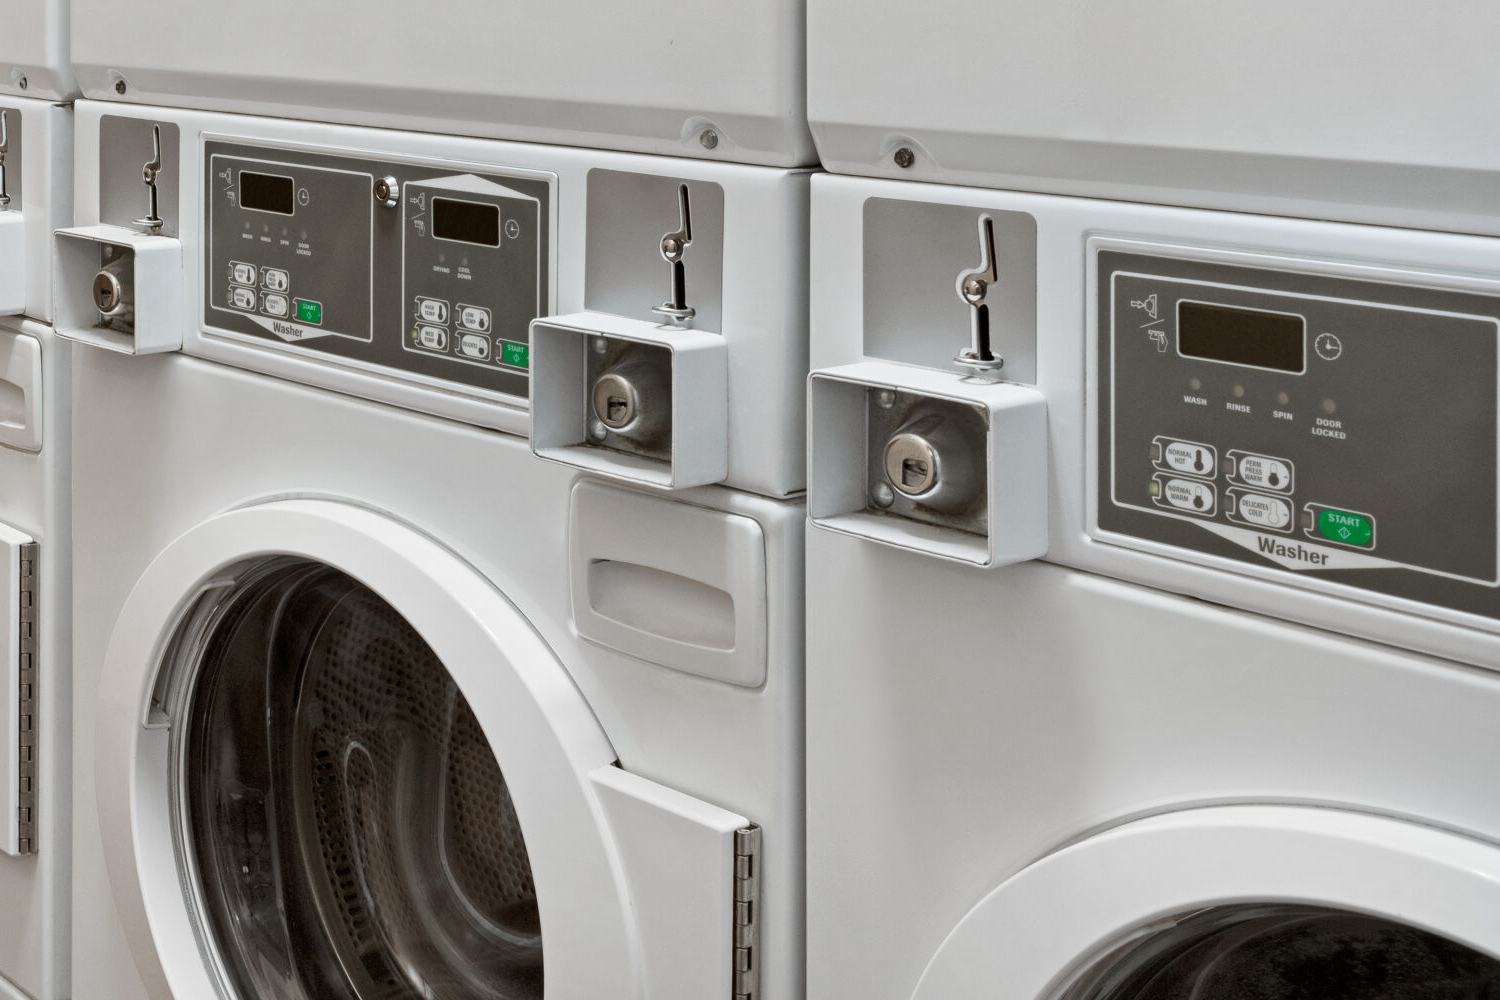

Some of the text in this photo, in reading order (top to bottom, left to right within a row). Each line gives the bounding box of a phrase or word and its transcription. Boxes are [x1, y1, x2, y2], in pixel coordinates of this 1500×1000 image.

[457, 273, 472, 281] DOWN
[273, 322, 303, 338] Washer
[507, 344, 525, 354] START
[1183, 395, 1207, 406] WASH
[1226, 402, 1251, 413] RINSE
[1273, 410, 1293, 420] SPIN
[1316, 418, 1342, 429] DOOR
[1311, 427, 1346, 439] LOCKED
[1167, 448, 1192, 459] NORMAL
[1174, 457, 1186, 465] HOT
[1245, 459, 1262, 468] PERM
[1244, 466, 1263, 475] PRESS
[1244, 473, 1263, 482] WARM
[1167, 485, 1192, 496] NORMAL
[1170, 493, 1189, 502] WARM
[1241, 499, 1269, 511] DELICATES
[1248, 508, 1263, 517] COLD
[1328, 513, 1361, 527] START
[1257, 536, 1329, 566] Washer
